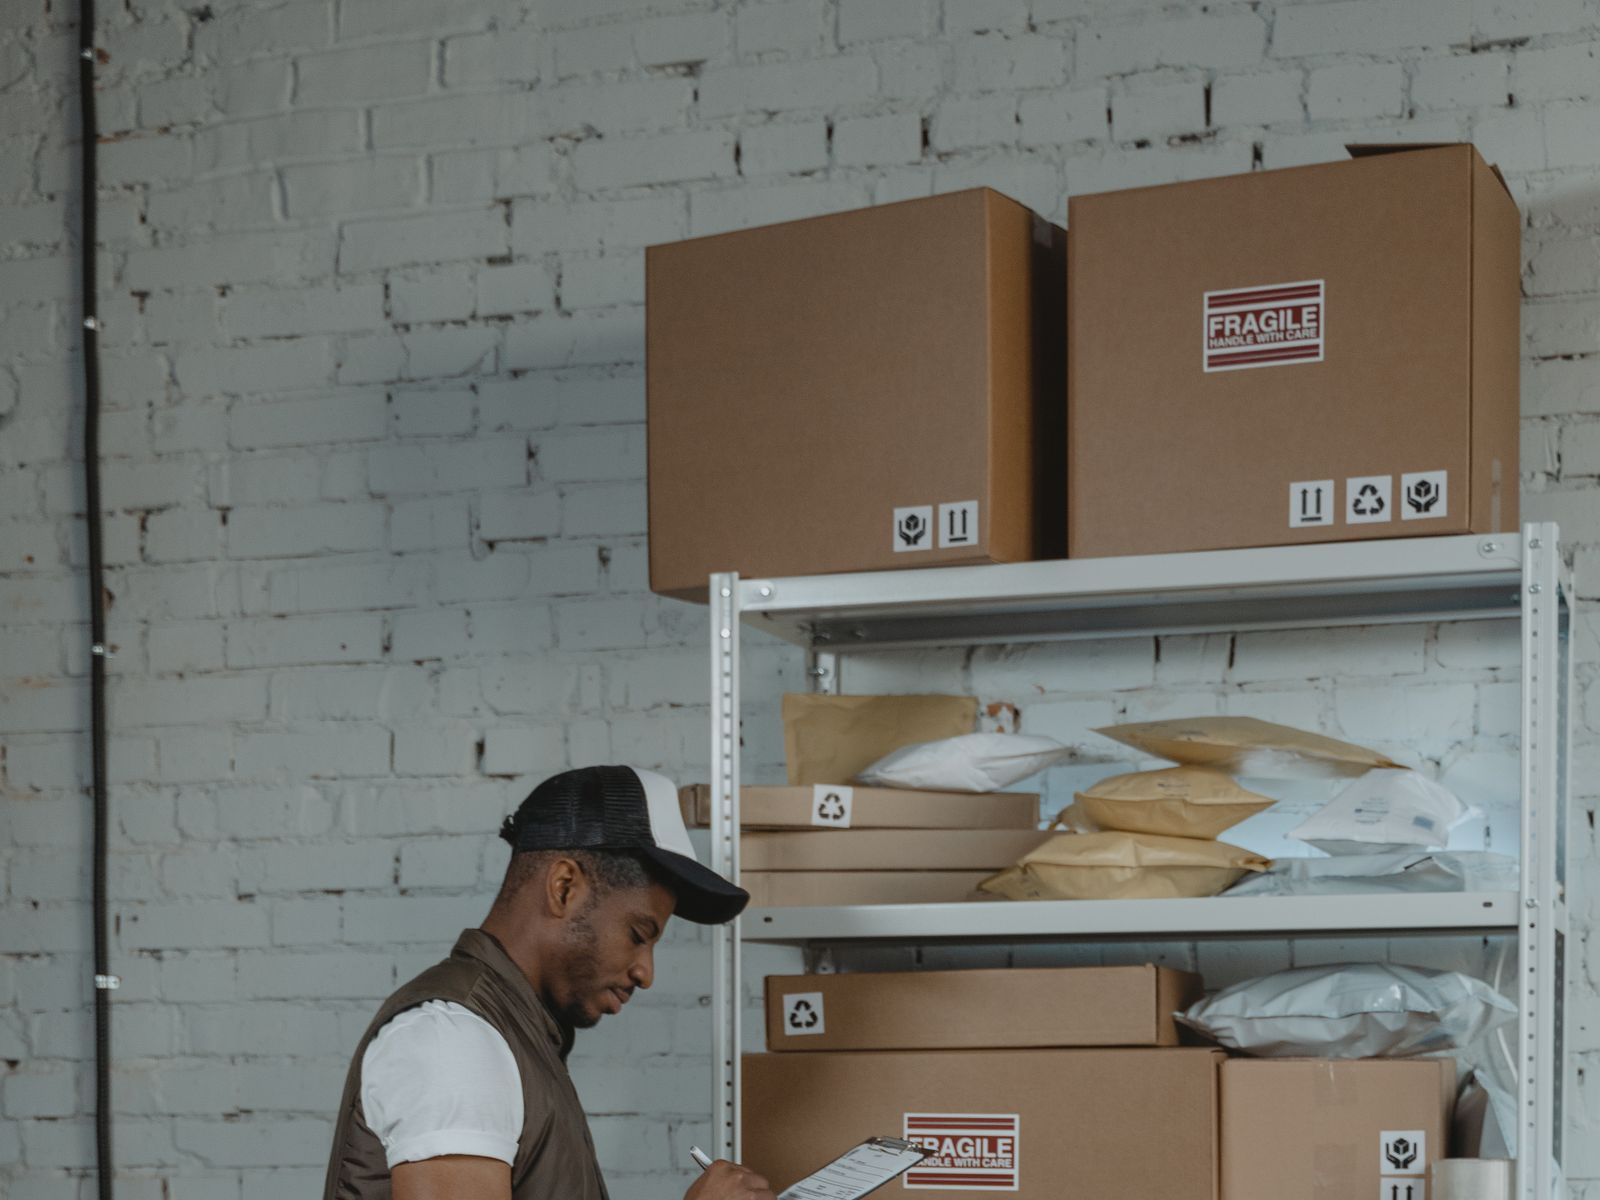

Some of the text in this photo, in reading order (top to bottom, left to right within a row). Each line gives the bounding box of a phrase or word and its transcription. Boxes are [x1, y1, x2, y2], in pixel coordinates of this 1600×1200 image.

[1209, 306, 1318, 338] FRAGILE
[1209, 328, 1317, 349] HANDLE WITH CARE
[916, 1157, 1012, 1168] ANDLE WITH CARE
